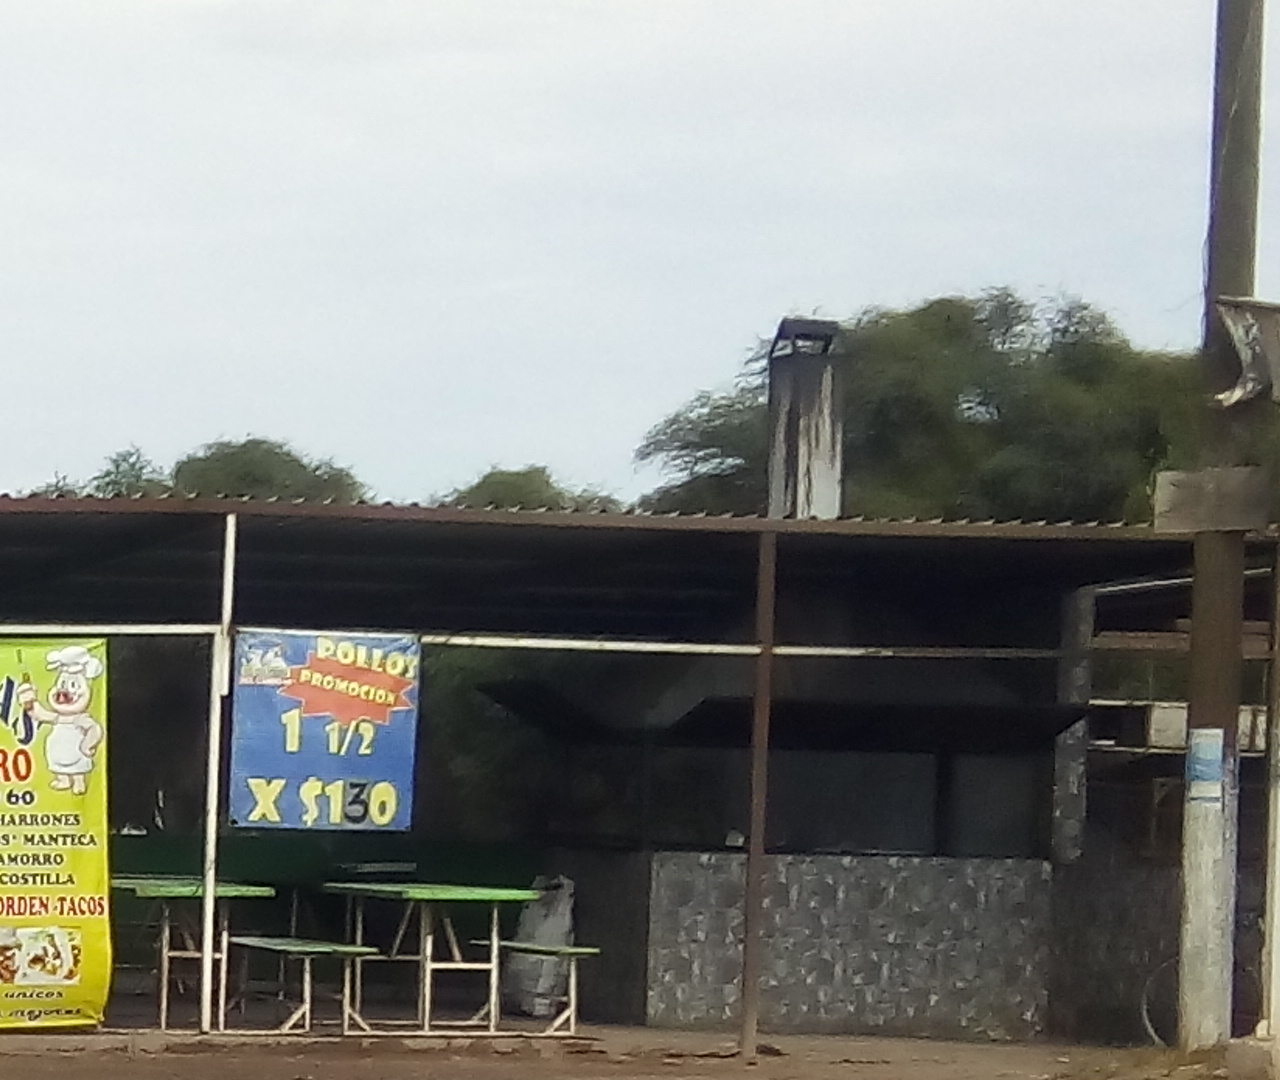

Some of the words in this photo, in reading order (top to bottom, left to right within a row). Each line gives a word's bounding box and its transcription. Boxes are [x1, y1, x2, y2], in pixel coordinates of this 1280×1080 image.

[298, 668, 398, 706] PROMOCION
[280, 707, 302, 752] 1
[324, 719, 376, 757] 1/2
[6, 787, 36, 806] 60
[246, 777, 288, 823] X
[299, 776, 398, 828] $130
[23, 833, 97, 847] MANTECA
